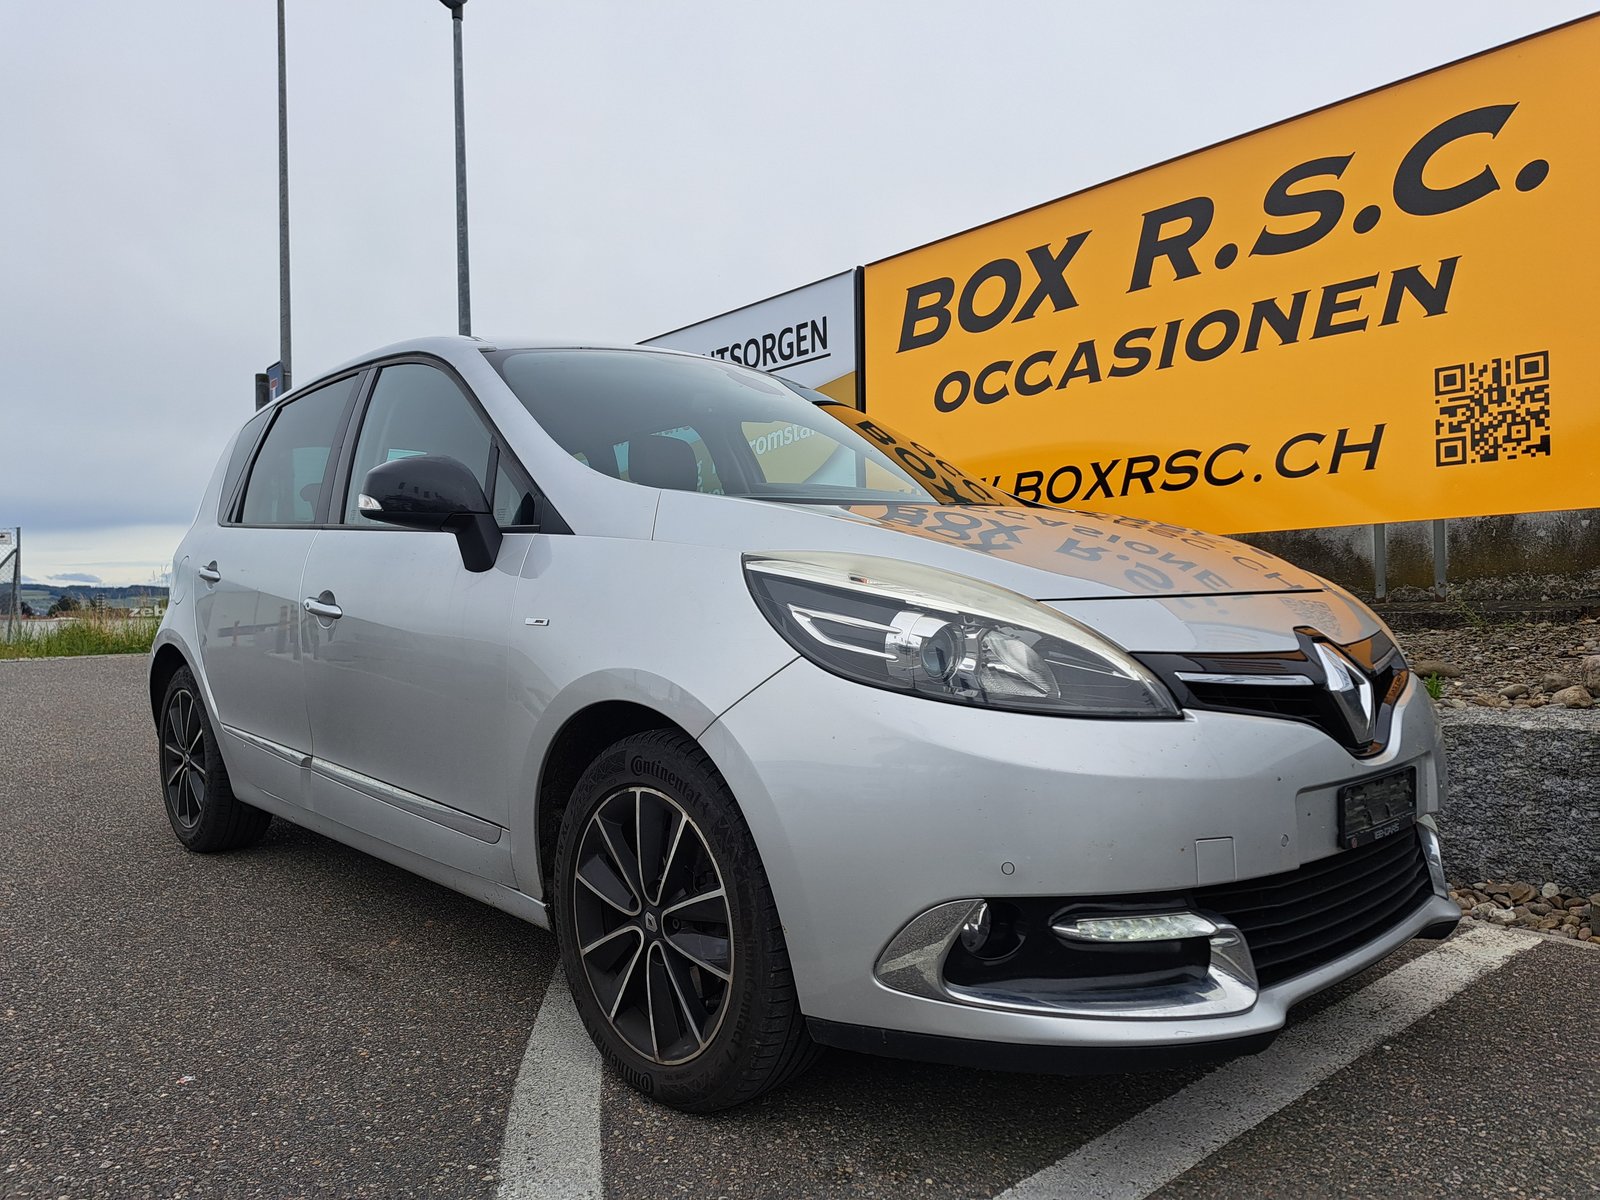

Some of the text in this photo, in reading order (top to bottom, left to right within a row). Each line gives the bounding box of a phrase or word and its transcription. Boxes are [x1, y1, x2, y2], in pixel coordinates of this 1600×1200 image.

[897, 101, 1550, 354] BOX R.S.C.
[934, 255, 1462, 413] OCCASIONEN
[630, 755, 699, 808] Continental
